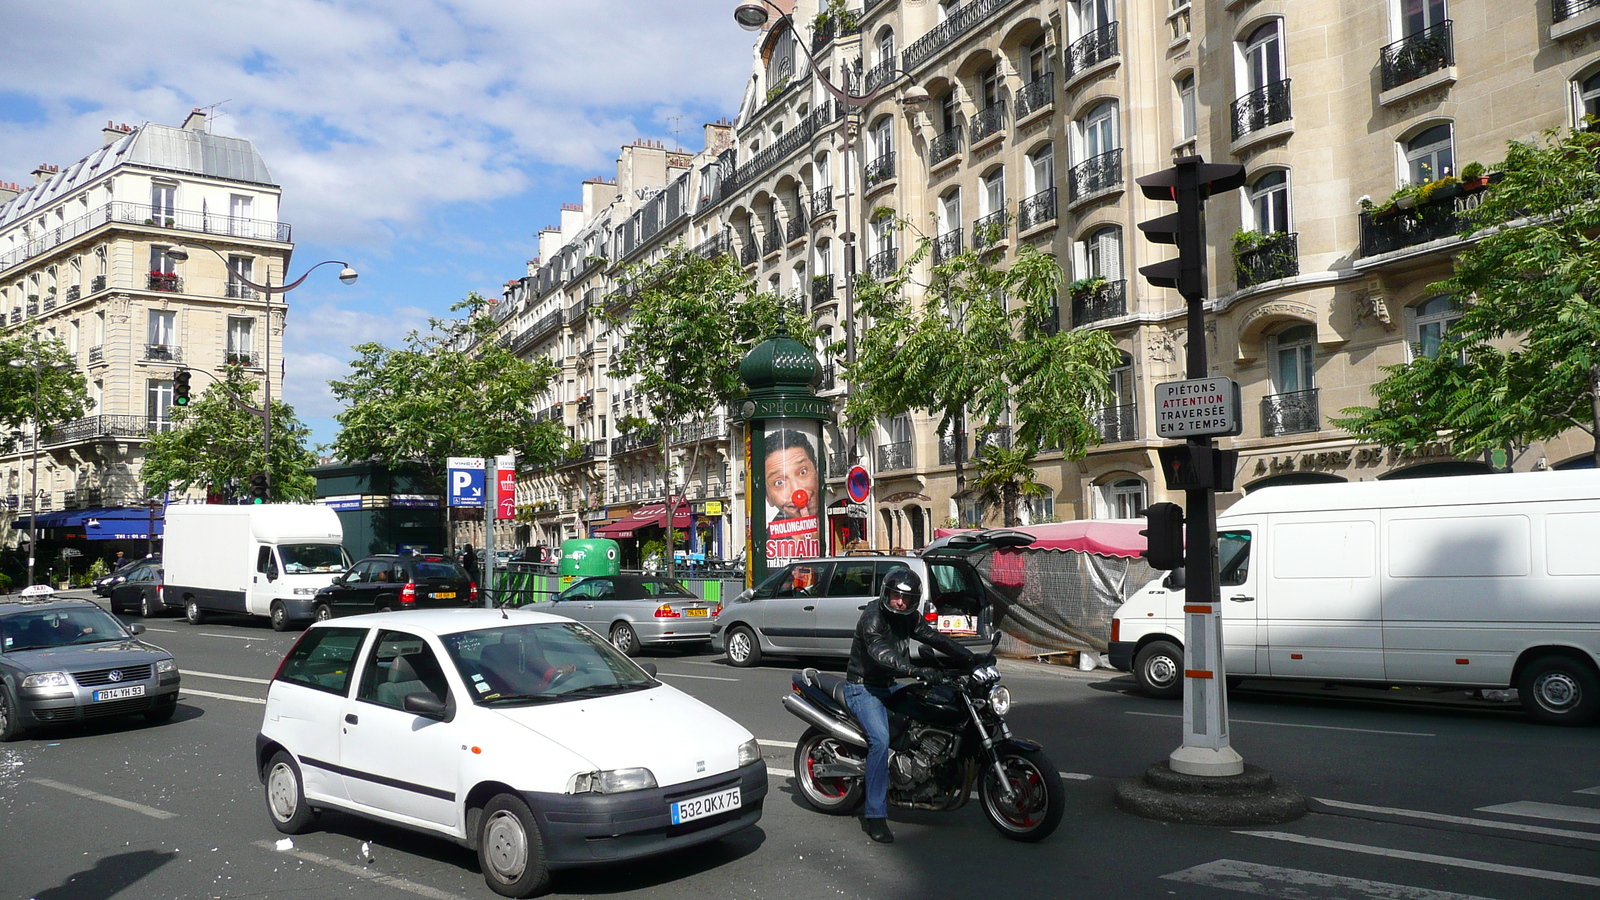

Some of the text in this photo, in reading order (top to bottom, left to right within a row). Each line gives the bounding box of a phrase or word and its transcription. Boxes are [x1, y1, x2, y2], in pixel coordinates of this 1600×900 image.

[1168, 382, 1216, 396] PIÉTONS
[761, 402, 829, 414] SPECTACLE
[1163, 394, 1223, 408] ATTENTION
[1161, 405, 1225, 420] TRAVERSÉE
[1161, 418, 1226, 432] EN 2 TEMPS
[1271, 456, 1295, 470] LA
[453, 471, 472, 496] P
[770, 518, 817, 535] PROLONGATIONS
[100, 686, 142, 700] 7814 YH 93
[680, 791, 739, 818] 532 QKX 75
